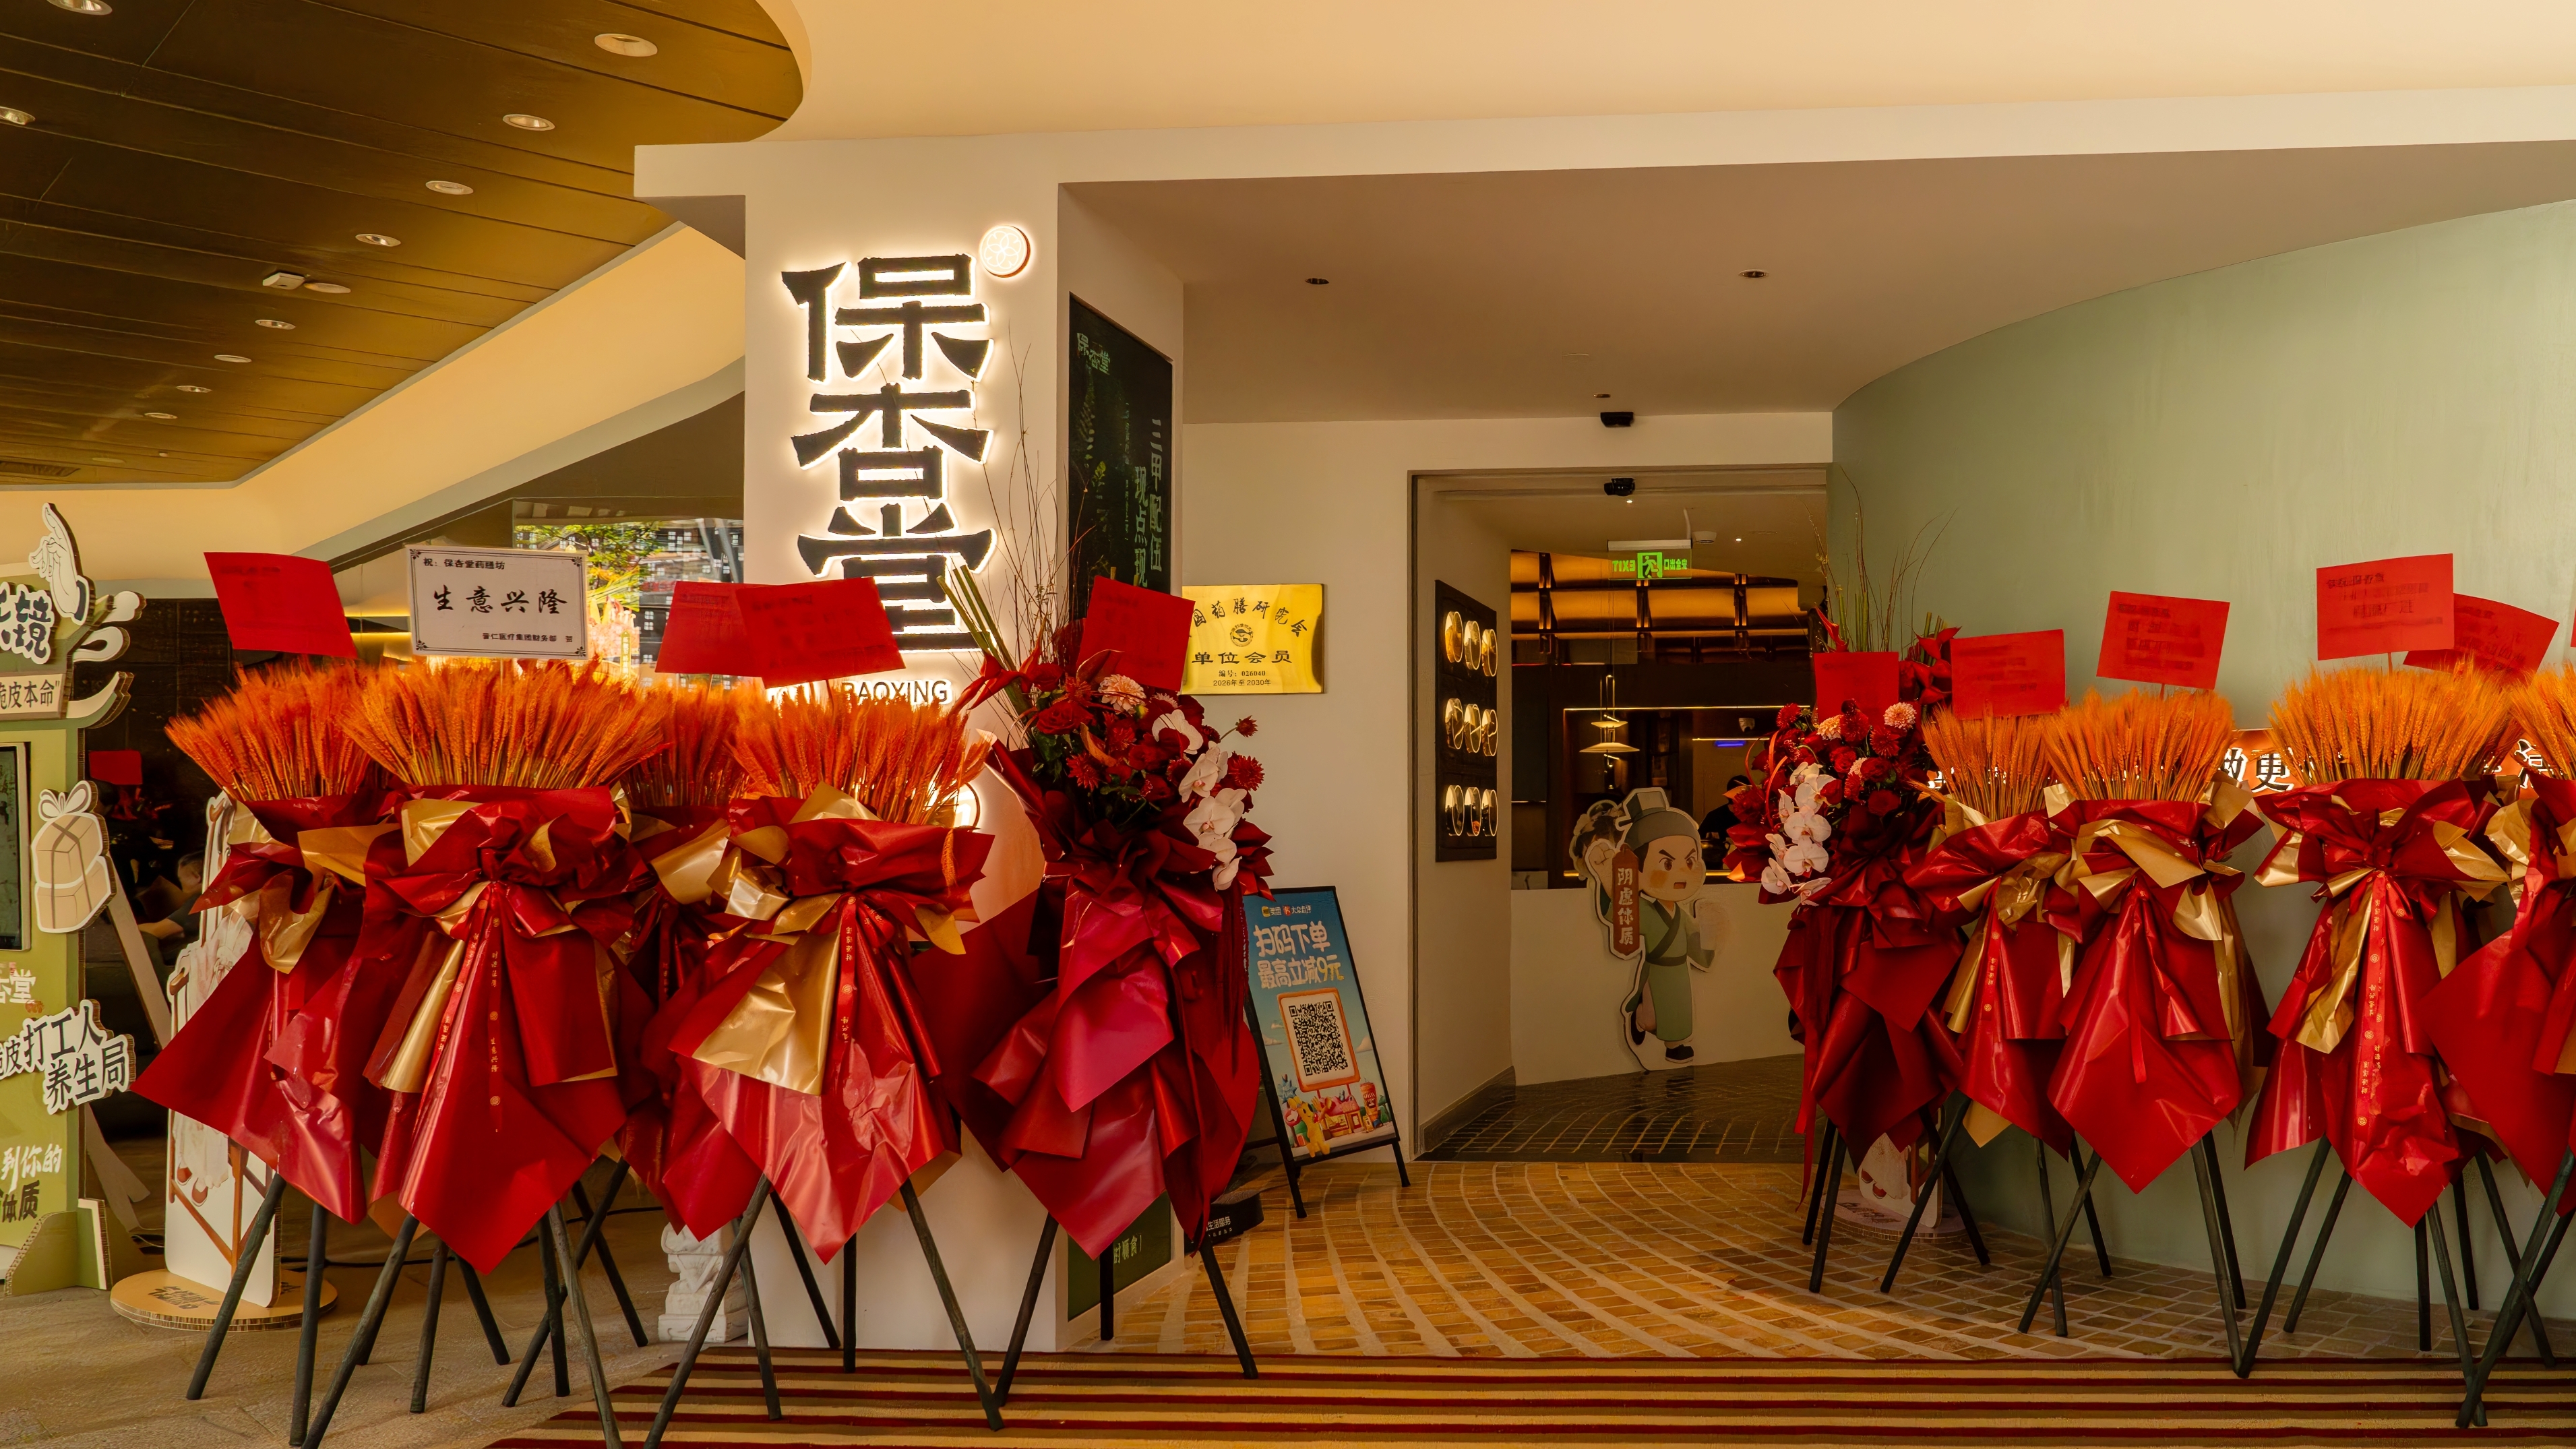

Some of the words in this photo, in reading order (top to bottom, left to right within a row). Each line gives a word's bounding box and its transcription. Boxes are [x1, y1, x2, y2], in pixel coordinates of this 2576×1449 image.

[781, 253, 995, 652] 保杏堂
[444, 559, 505, 570] 保杏堂药膳坊
[433, 584, 567, 614] 生意兴隆
[1188, 597, 1308, 638] 国药膳研究会
[1192, 650, 1292, 665] 单位会员
[1618, 867, 1634, 946] 阴虚体质
[1253, 921, 1331, 958] 扫码下单
[1257, 954, 1343, 989] 最高立减9元
[0, 1006, 103, 1078] 皮打工人
[47, 1041, 126, 1109] 养生局
[0, 1143, 63, 1195] 到你的
[0, 1179, 40, 1223] 体质
[1206, 1216, 1231, 1232] 生活服务
